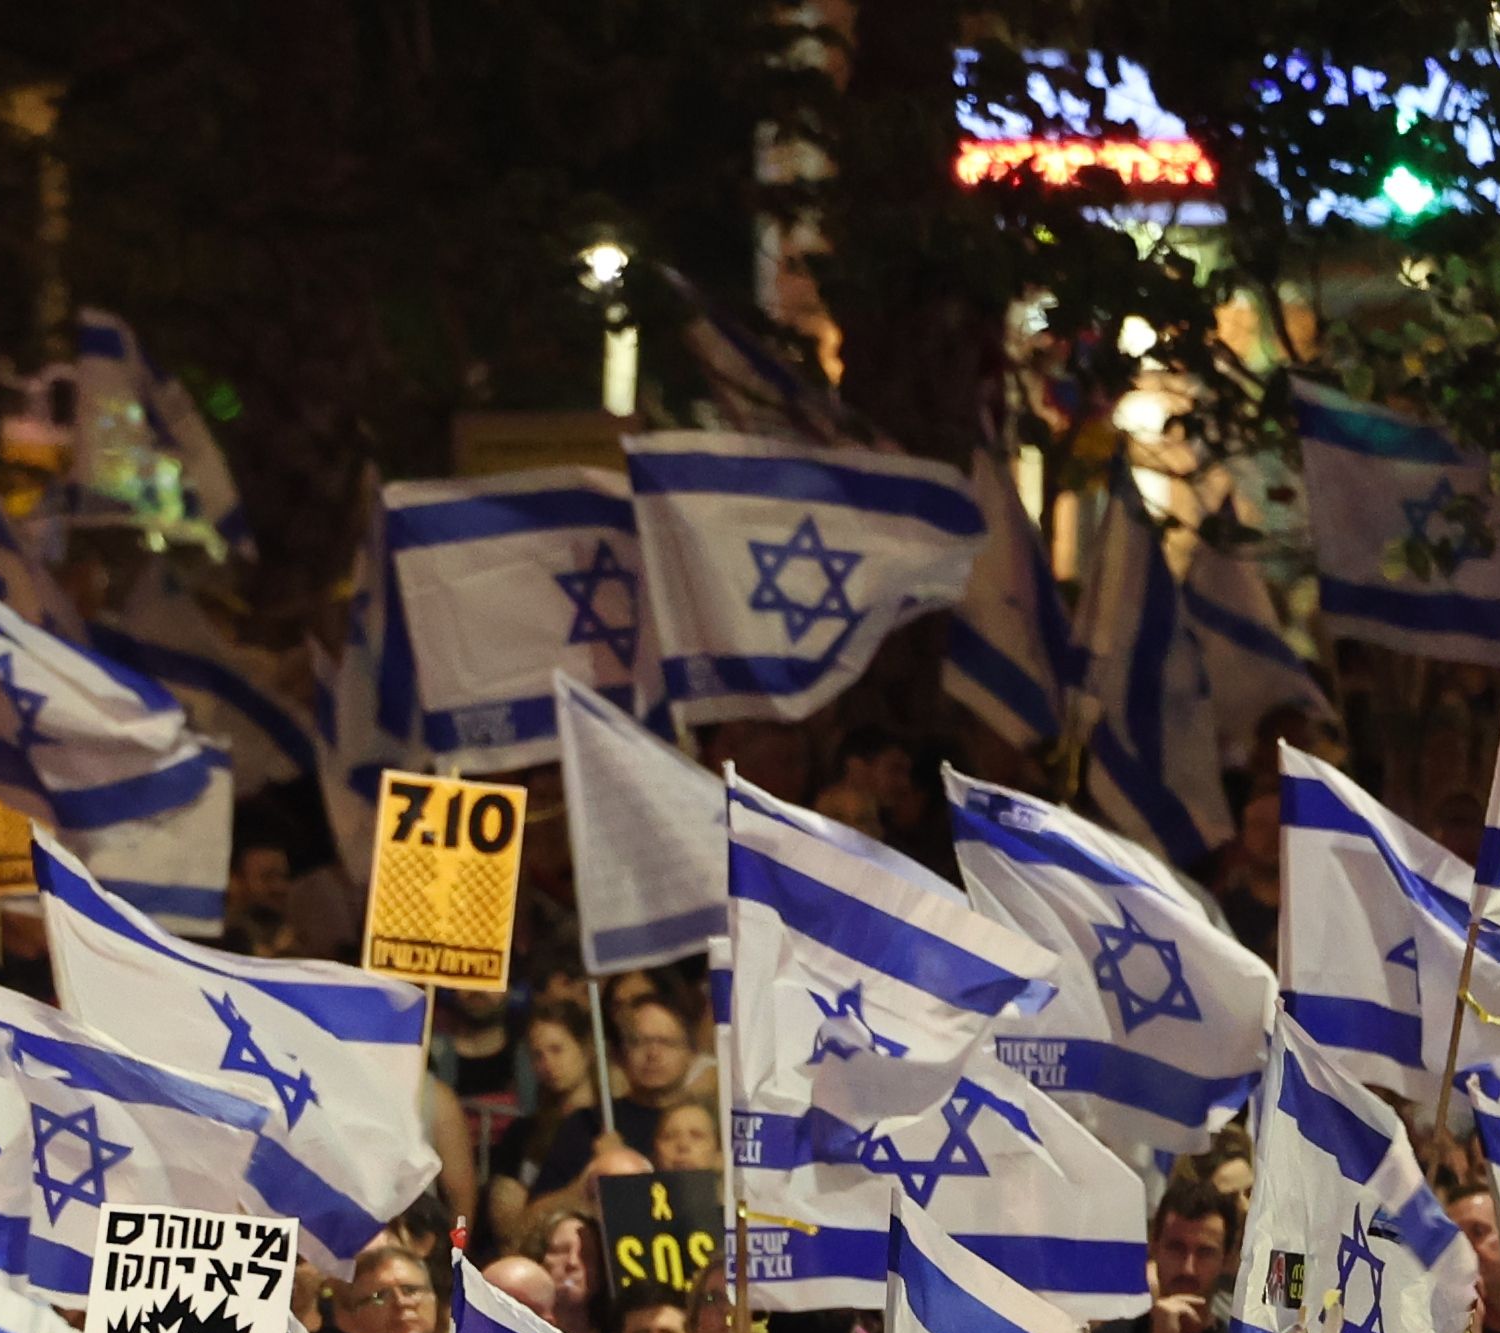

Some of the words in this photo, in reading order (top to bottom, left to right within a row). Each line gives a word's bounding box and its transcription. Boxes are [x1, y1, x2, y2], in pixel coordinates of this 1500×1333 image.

[391, 782, 516, 856] 7.10
[106, 1211, 225, 1251] שהרס
[235, 1221, 290, 1262] מי
[105, 1252, 196, 1292] יתקן
[203, 1258, 283, 1300] לא
